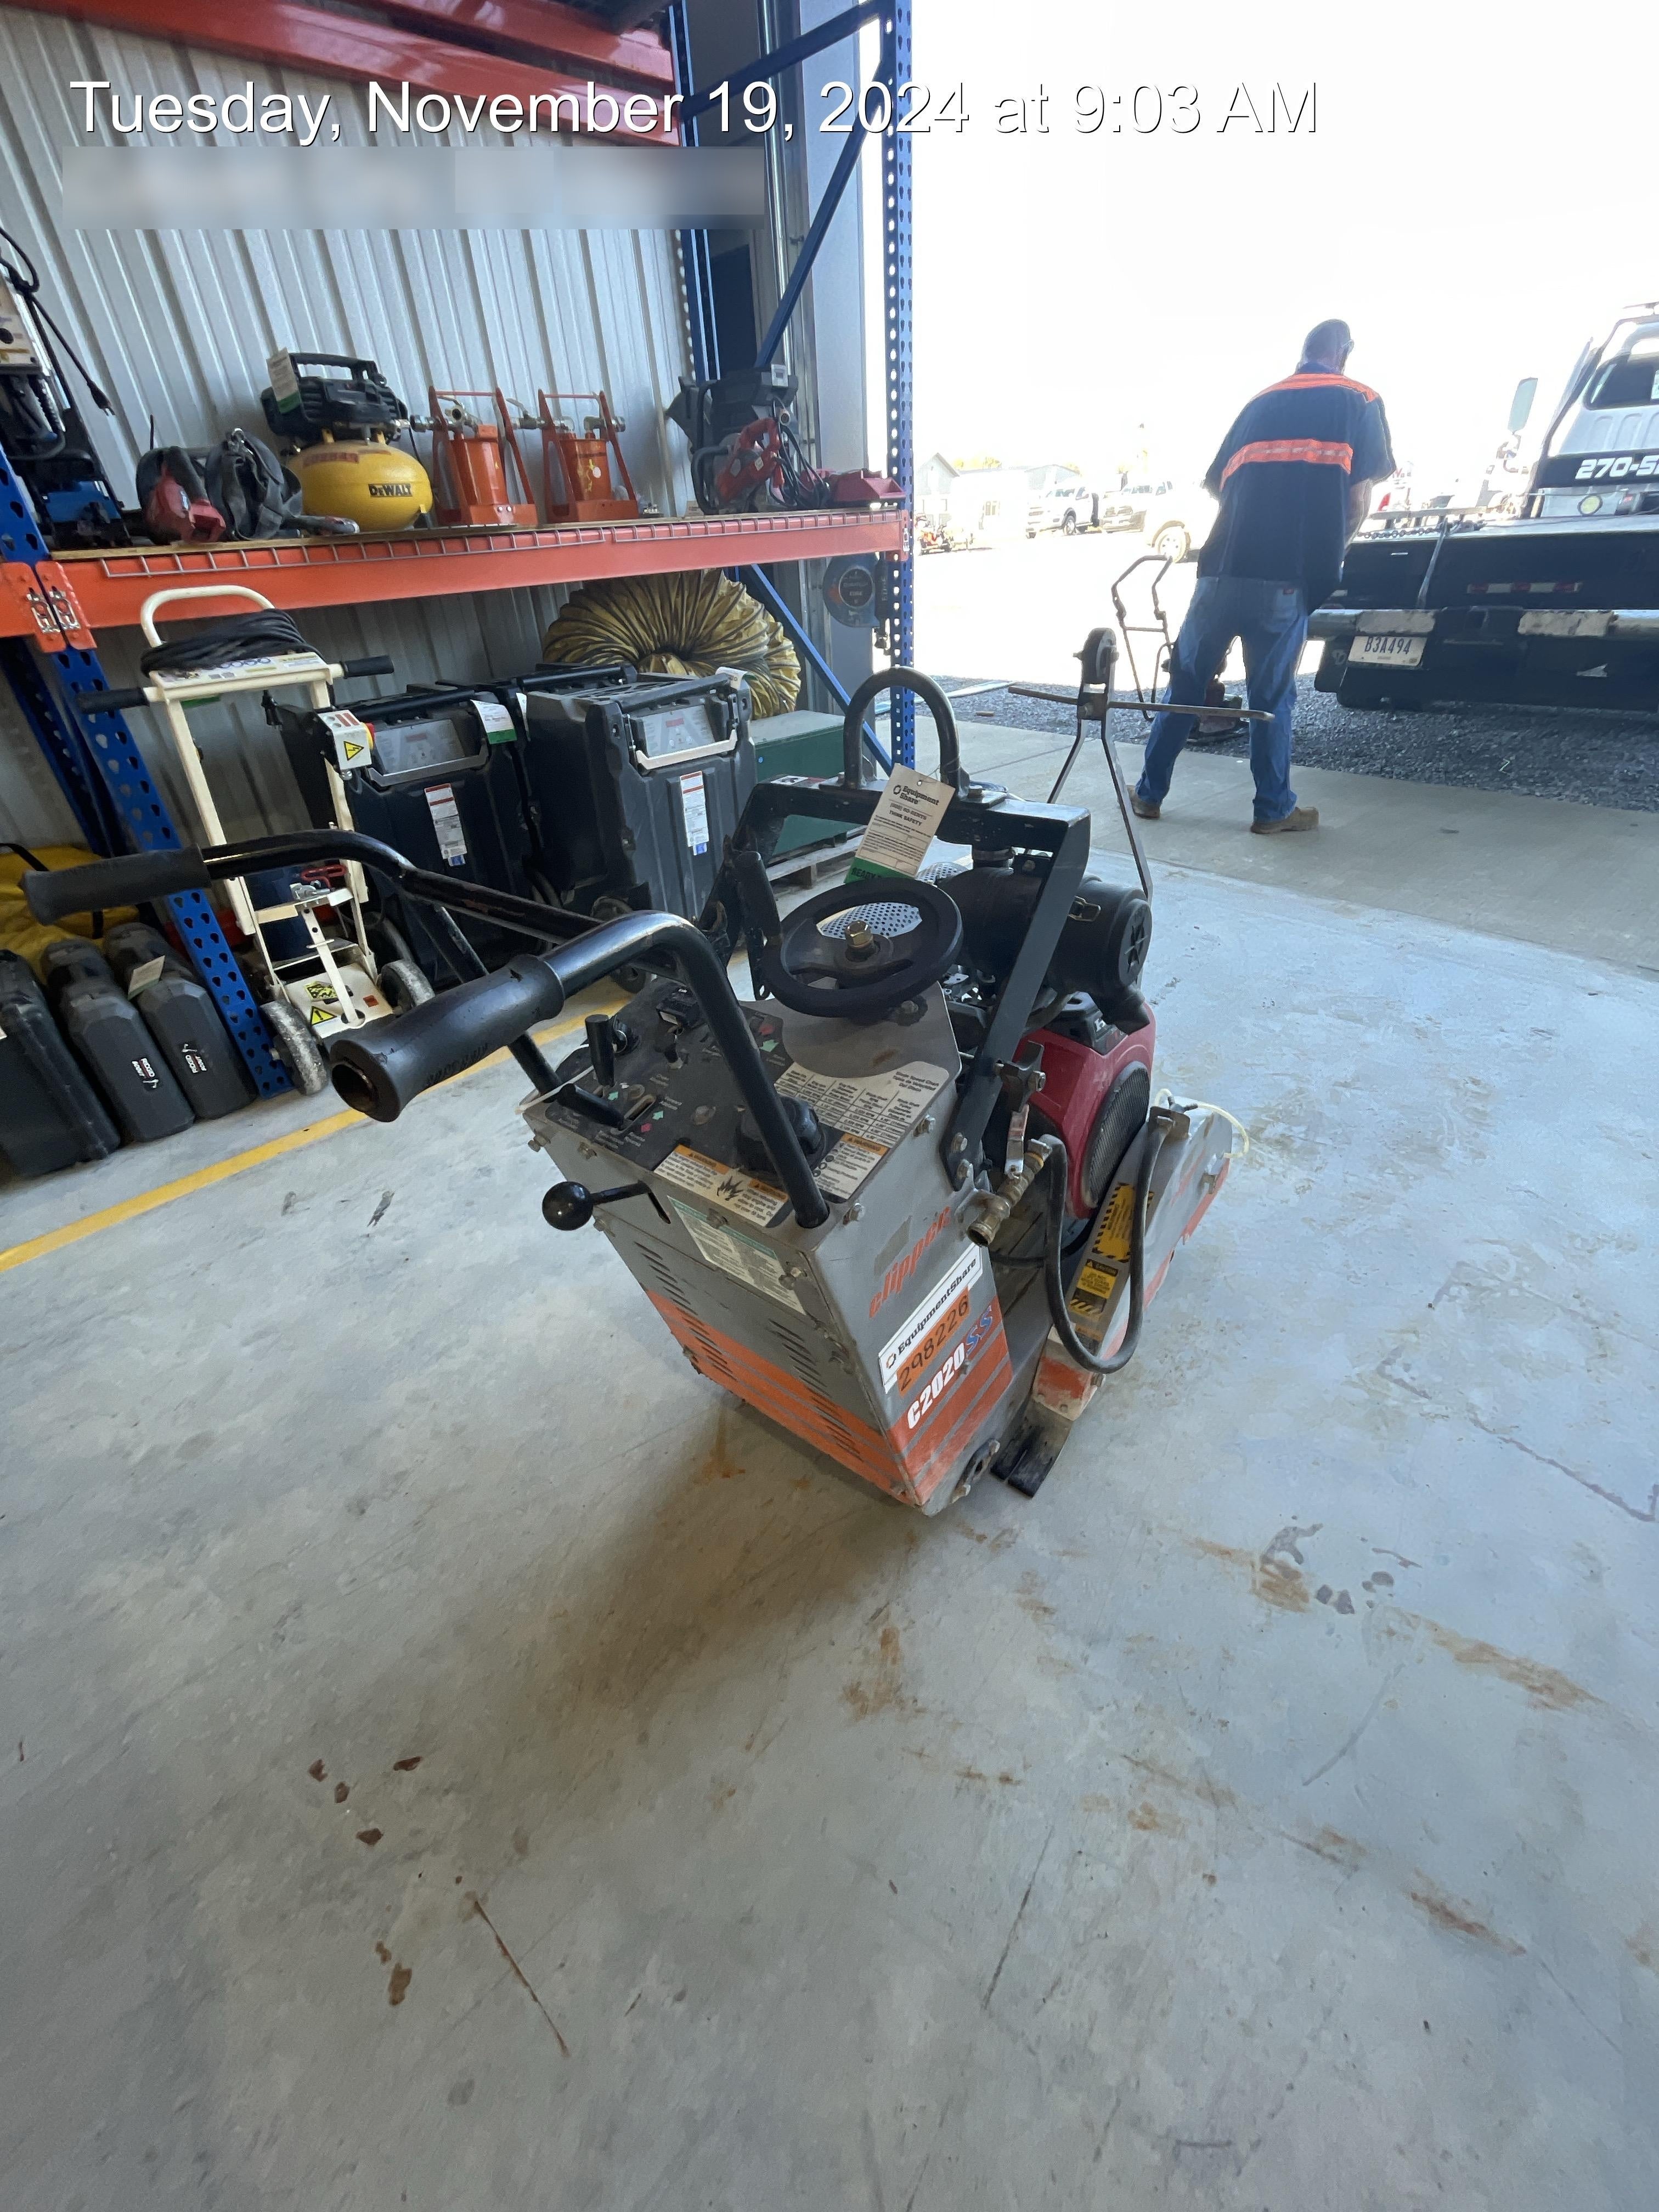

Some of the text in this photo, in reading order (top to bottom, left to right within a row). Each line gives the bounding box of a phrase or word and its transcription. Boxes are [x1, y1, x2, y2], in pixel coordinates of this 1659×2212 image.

[1575, 455, 1659, 479] 270-5
[1364, 636, 1412, 654] B3A494
[900, 793, 918, 805] Share
[902, 786, 939, 805] Equipment
[904, 816, 922, 826] SAFETY
[898, 1259, 977, 1355] EquipmentShare
[899, 1295, 969, 1392] 298226
